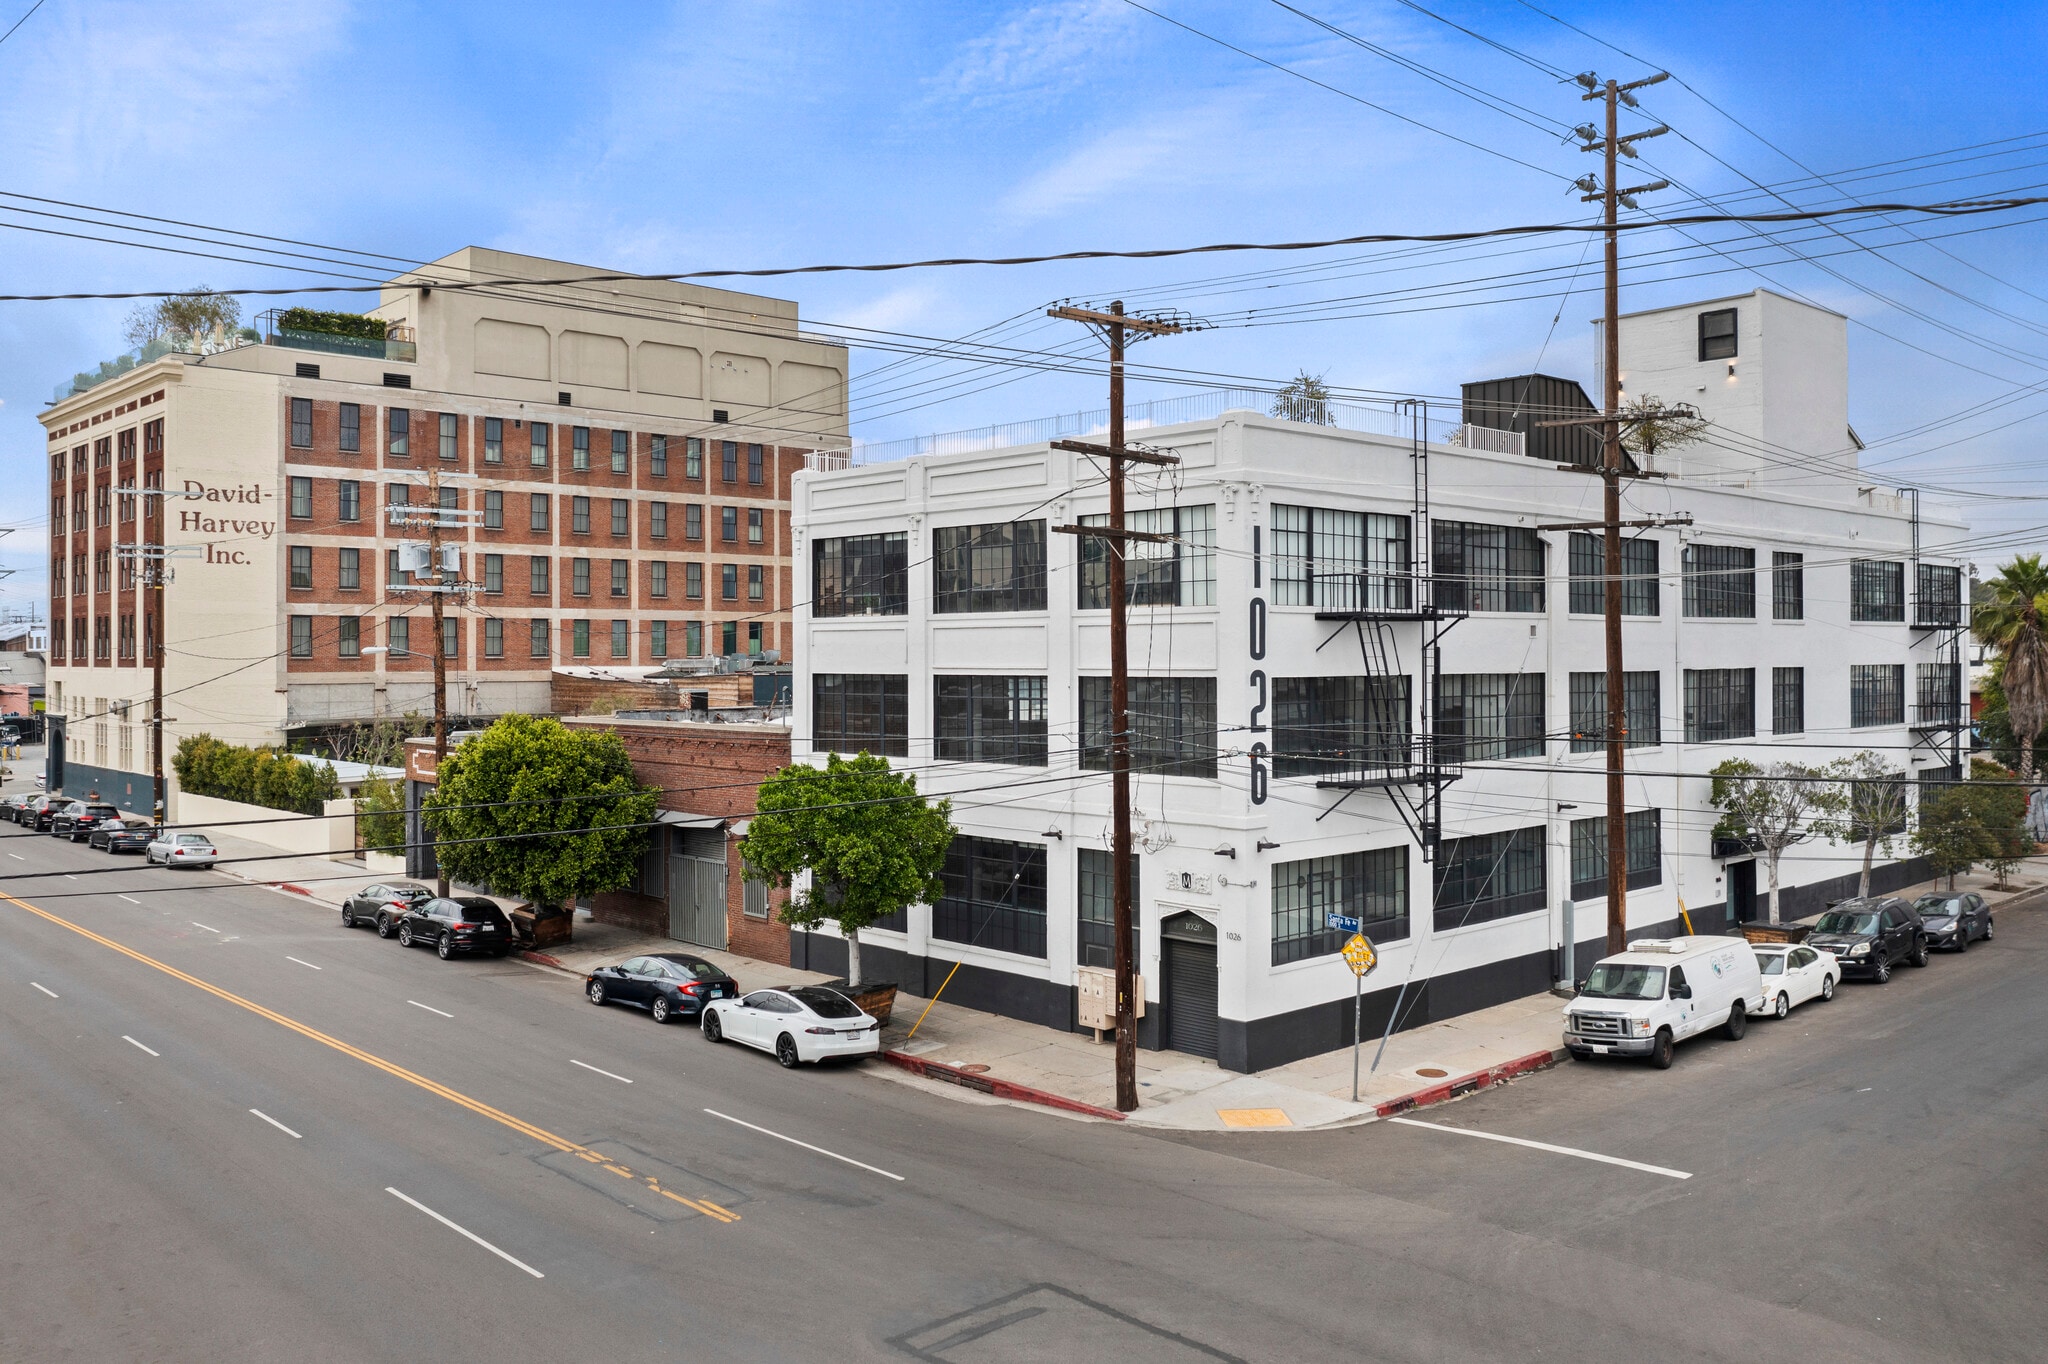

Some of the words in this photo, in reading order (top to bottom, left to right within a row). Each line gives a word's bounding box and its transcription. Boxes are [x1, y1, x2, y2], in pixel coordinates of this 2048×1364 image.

[183, 480, 272, 504] David-
[180, 511, 276, 539] Harvey
[206, 543, 251, 565] Inc.
[1250, 525, 1267, 805] 1026
[1185, 922, 1203, 931] 1026
[1329, 914, 1343, 924] Santa
[1226, 932, 1241, 941] 1026
